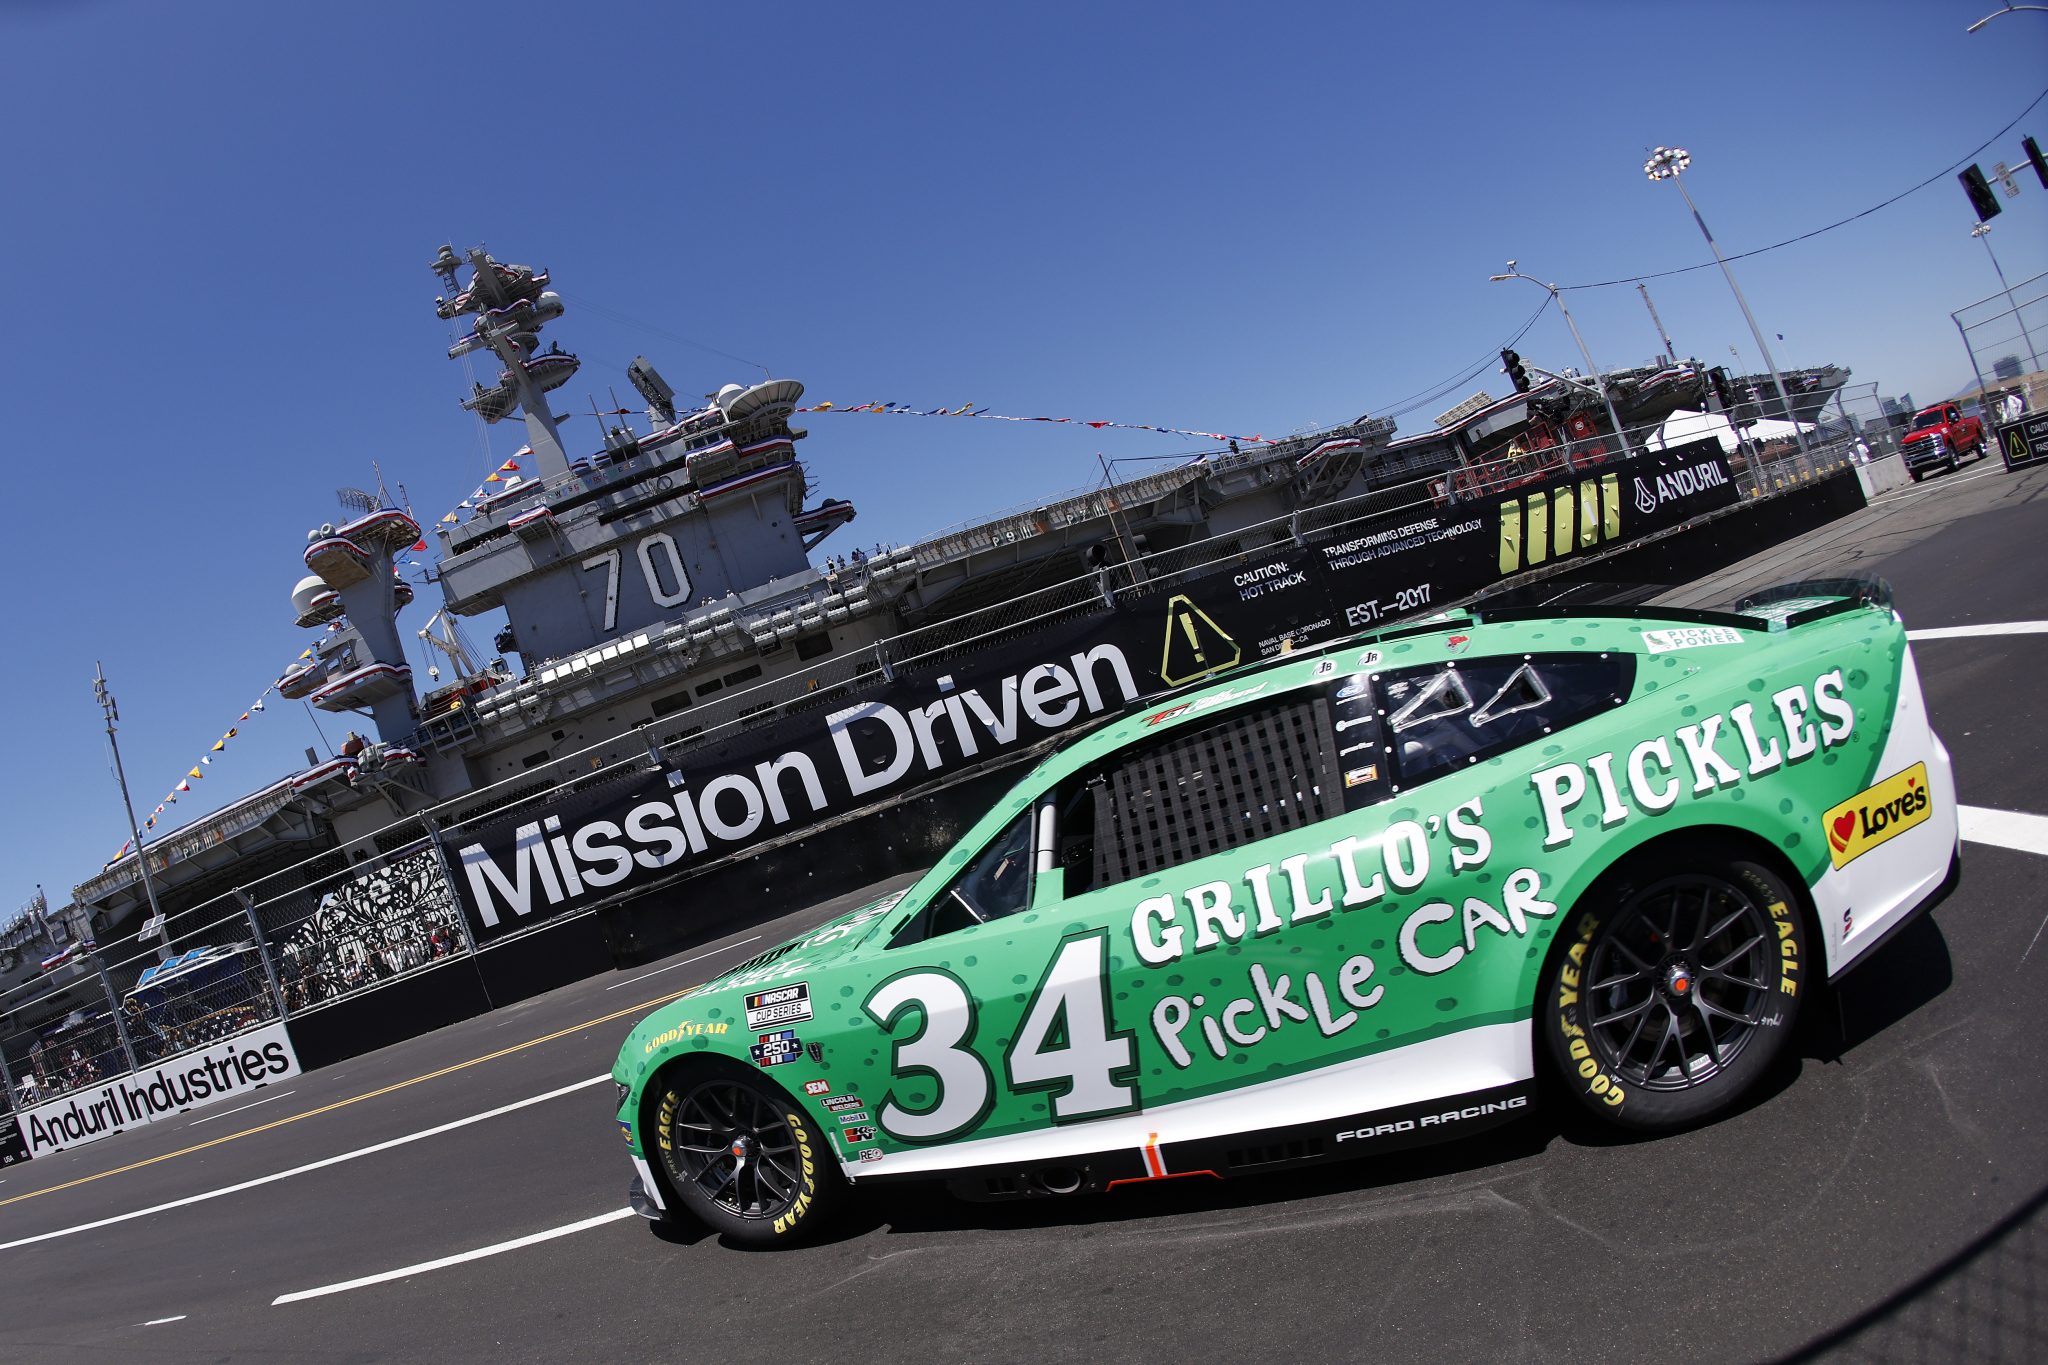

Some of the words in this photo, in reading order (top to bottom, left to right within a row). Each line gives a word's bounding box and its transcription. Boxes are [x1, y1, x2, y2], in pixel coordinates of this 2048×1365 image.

[1656, 460, 1729, 503] ANDURIL
[1322, 529, 1398, 558] TRANSFORMING
[1398, 518, 1439, 537] DEFENSE
[1328, 549, 1377, 571] THROUGH
[1377, 535, 1426, 558] ADVANCED
[1427, 519, 1483, 543] TECHNOLOGY
[582, 532, 692, 631] 70
[1234, 561, 1290, 587] CAUTION:
[1239, 585, 1264, 602] HOT
[1265, 570, 1307, 593] TRACK
[1258, 636, 1279, 648] NAVAL
[1278, 630, 1295, 642] BASE
[1295, 618, 1331, 637] CORONADO
[1261, 645, 1275, 656] SAN
[1667, 628, 1734, 640] PICKLE
[1673, 635, 1738, 648] POWER
[460, 750, 829, 928] Mission
[826, 643, 1140, 798] Driven
[1130, 796, 1493, 967] GRILLO'S
[1530, 668, 1855, 847] PICKLES
[1397, 866, 1558, 974] CAR
[1767, 901, 1799, 997] EAGLE
[756, 1008, 774, 1022] CUP
[774, 1003, 802, 1018] SERIES
[765, 988, 799, 1004] NASCAR
[763, 1041, 790, 1056] 250
[865, 932, 1138, 1141] 34
[29, 1087, 125, 1152] Anduril
[118, 1040, 290, 1122] Industries
[806, 1081, 830, 1095] SEM
[822, 1095, 854, 1106] LINCOLN
[658, 1090, 680, 1151] EAGLE
[840, 1114, 859, 1123] Mobil
[1336, 1120, 1415, 1143] FORD
[1420, 1095, 1528, 1128] RACING
